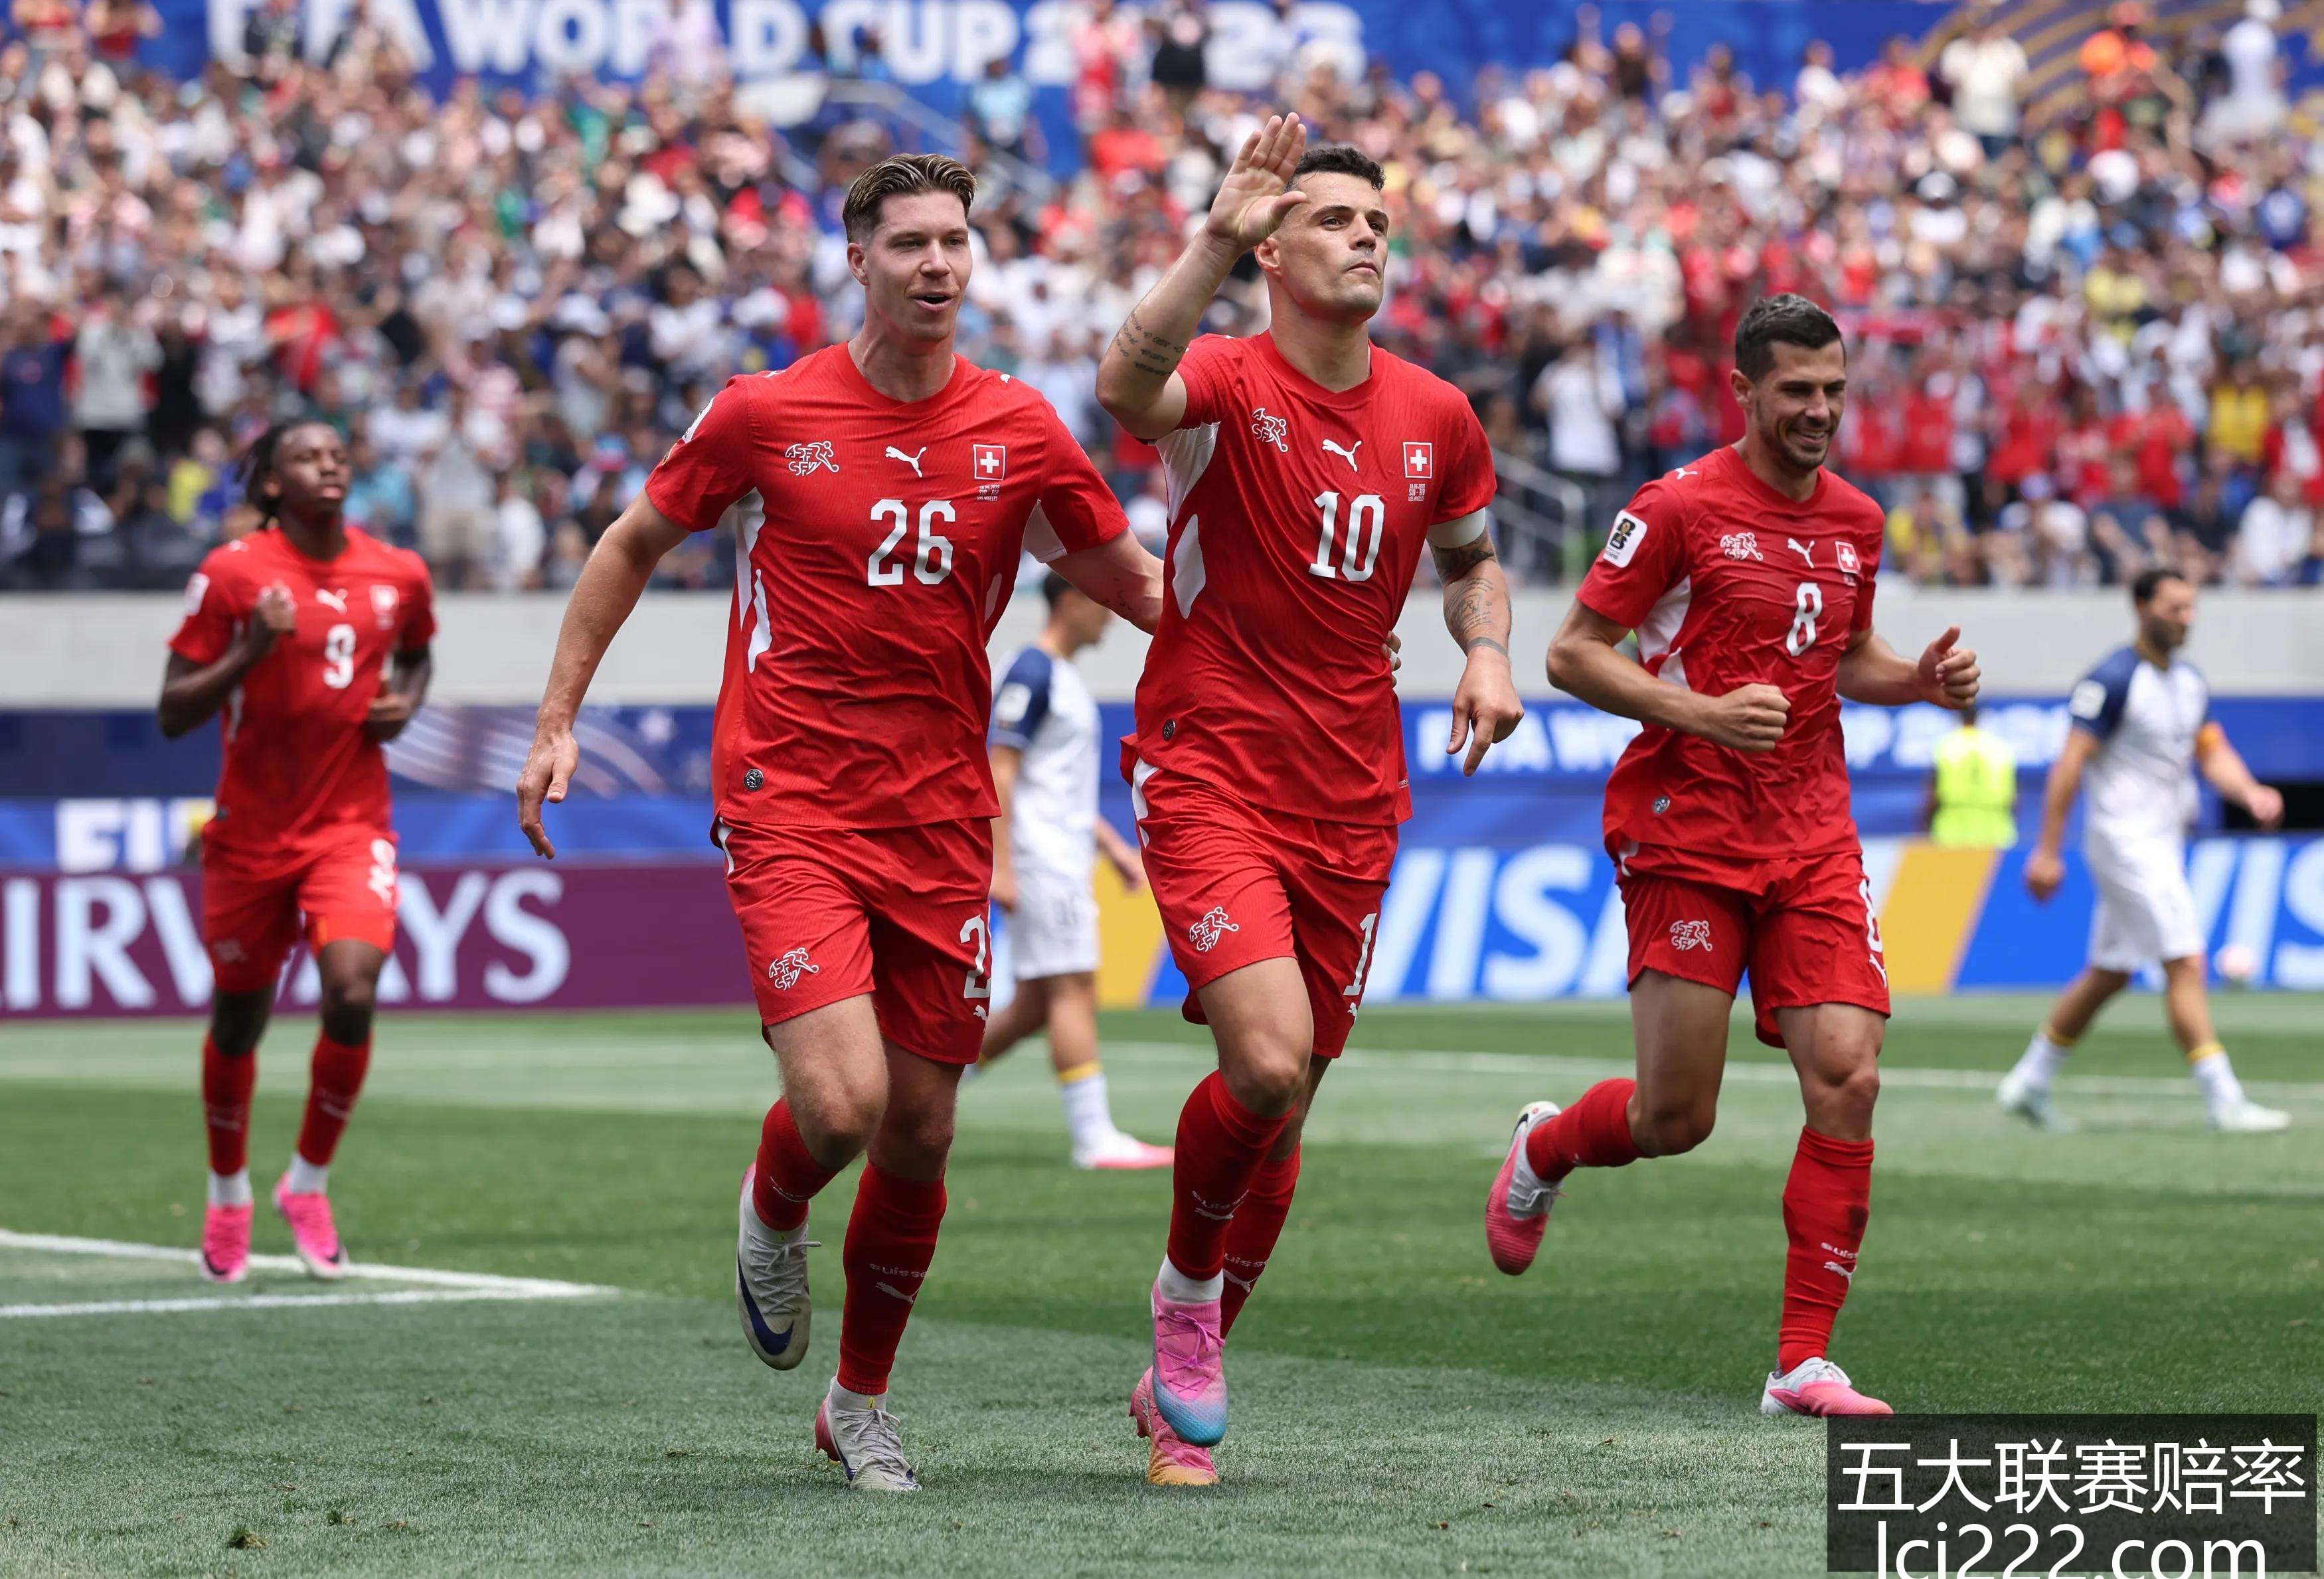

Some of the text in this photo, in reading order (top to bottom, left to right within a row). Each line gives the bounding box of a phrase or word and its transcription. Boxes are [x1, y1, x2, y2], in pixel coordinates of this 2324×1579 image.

[867, 499, 956, 586] 26
[1309, 491, 1384, 582] 10
[323, 623, 357, 689] 9
[1786, 582, 1823, 657] 8
